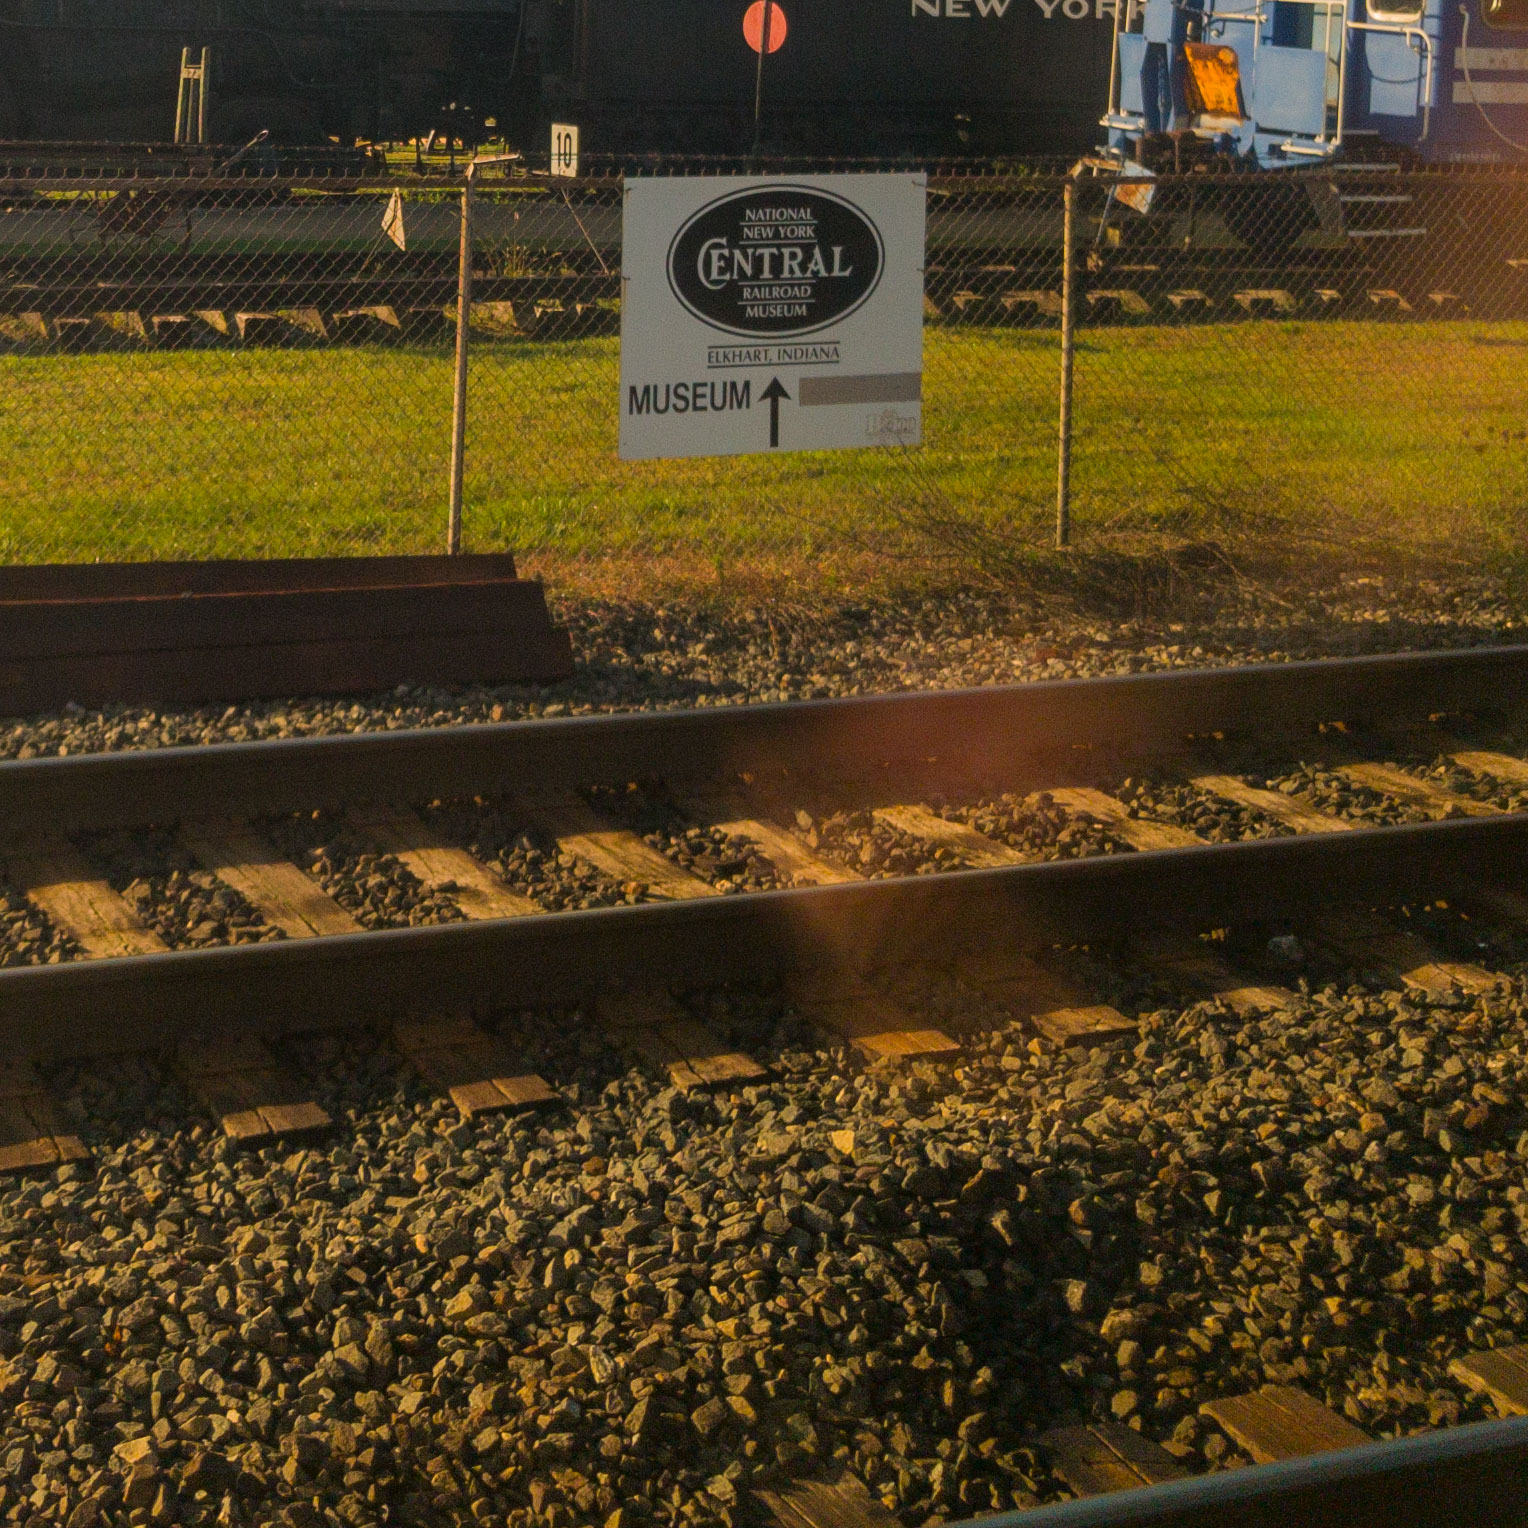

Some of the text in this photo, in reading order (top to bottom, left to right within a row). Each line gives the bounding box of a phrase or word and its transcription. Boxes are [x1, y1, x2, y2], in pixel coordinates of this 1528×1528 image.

[557, 132, 572, 169] 10
[745, 207, 813, 221] NATIONAL
[743, 225, 815, 239] NEW YORK
[697, 237, 853, 290] CENTRAL
[743, 286, 811, 299] RAILROAD
[746, 304, 807, 318] MUSEUM
[707, 345, 840, 364] ELKHART, INDIANA
[628, 380, 751, 415] MUSEUM
